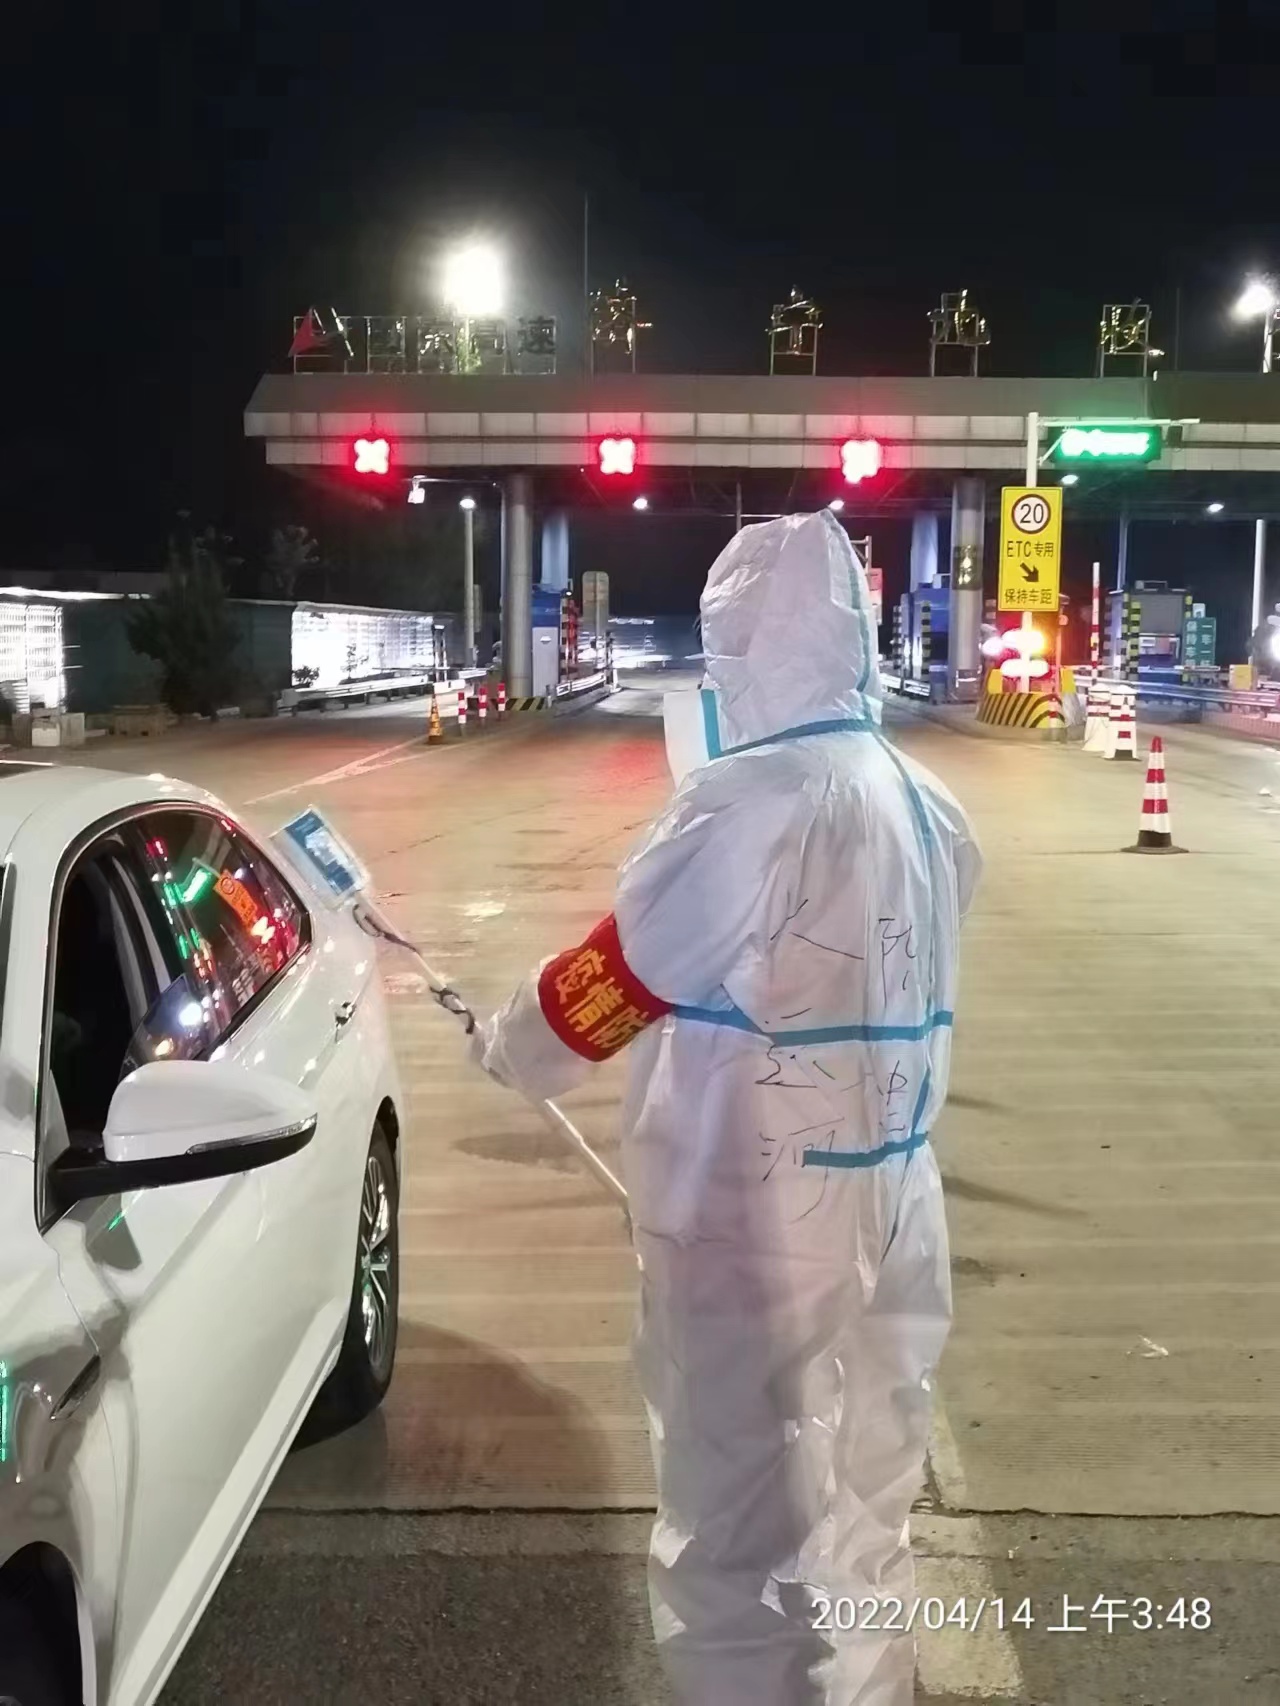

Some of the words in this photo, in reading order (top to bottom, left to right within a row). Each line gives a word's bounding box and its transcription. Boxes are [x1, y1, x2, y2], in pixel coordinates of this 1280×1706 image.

[1020, 503, 1044, 524] 20
[1004, 588, 1053, 605] 保持车距
